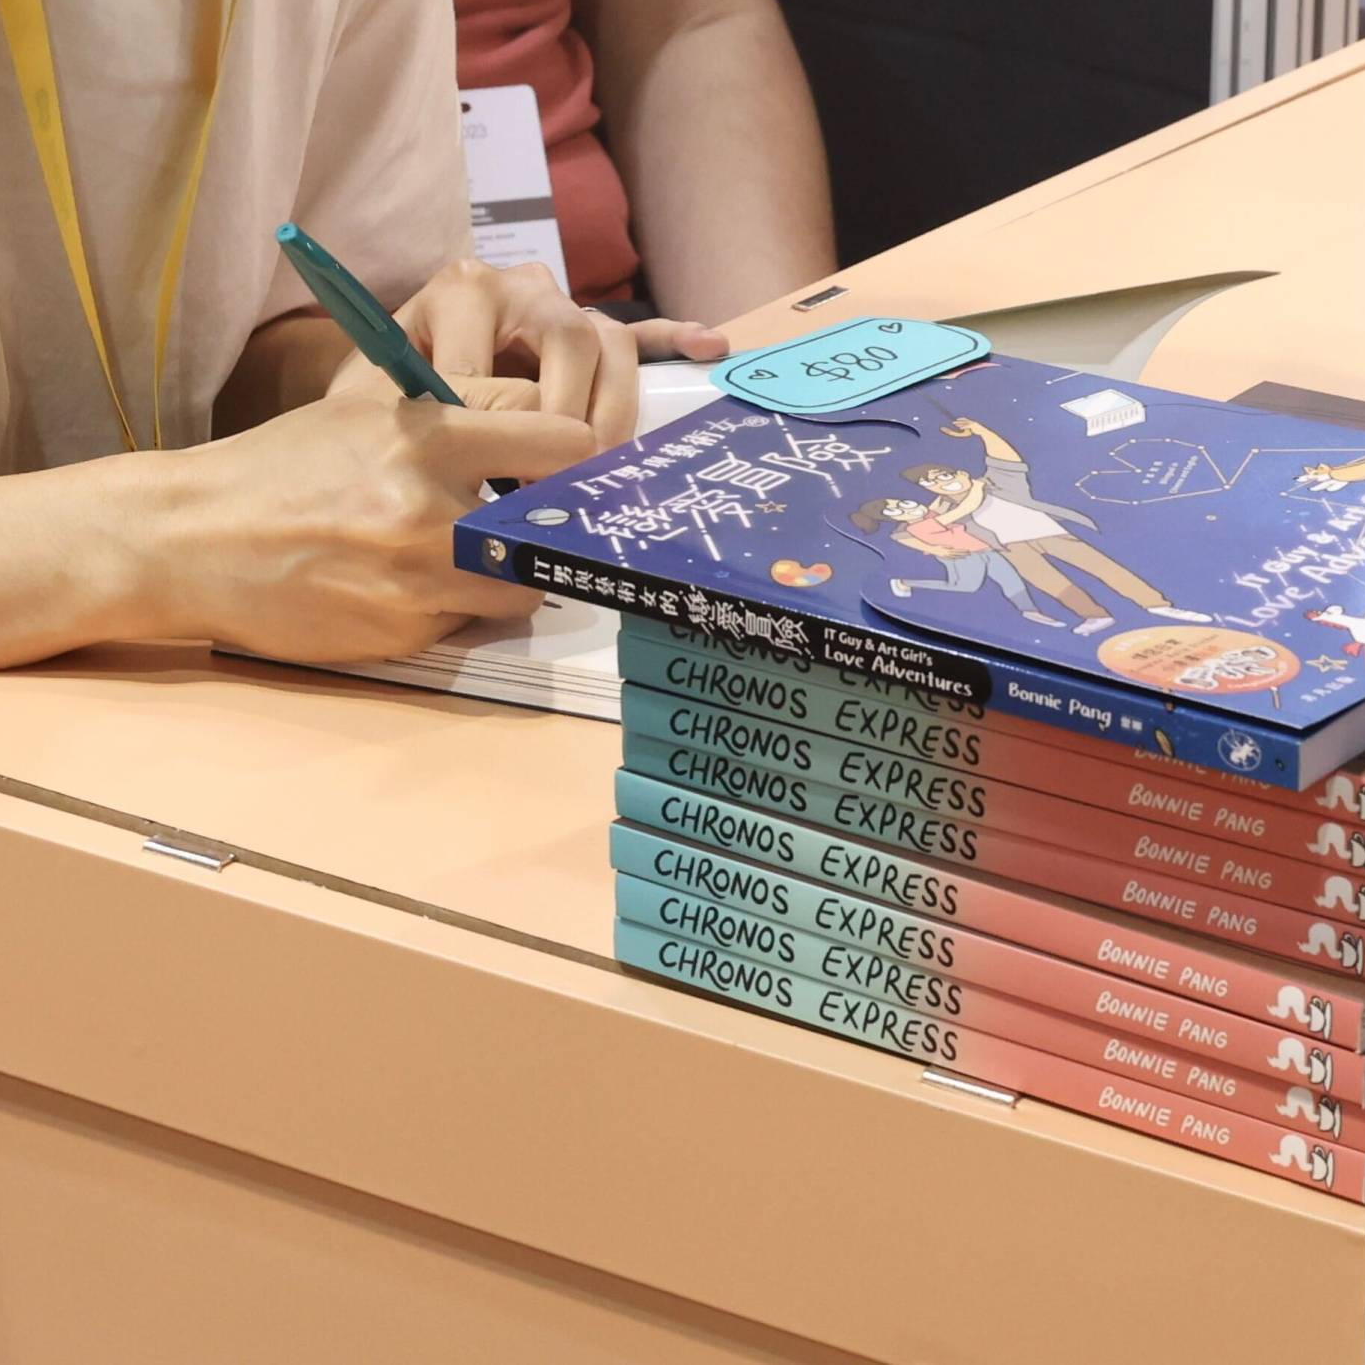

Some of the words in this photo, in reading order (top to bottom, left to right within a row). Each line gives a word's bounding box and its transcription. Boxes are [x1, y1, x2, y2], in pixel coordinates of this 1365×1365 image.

[805, 344, 899, 384] $80
[1225, 585, 1316, 629] Love
[1306, 529, 1336, 545] &
[823, 627, 838, 642] IT
[838, 631, 864, 653] Guy
[864, 638, 876, 653] &
[877, 641, 900, 659] Art
[900, 646, 933, 668] Girl's
[823, 643, 865, 670] Love
[871, 654, 973, 698] Adventures
[1007, 681, 1064, 713] Bonnie
[1068, 697, 1113, 731] Pang
[666, 657, 808, 721] CHRONOS
[835, 700, 981, 766] EXPRESS
[1128, 783, 1204, 821] BONNIE
[1214, 807, 1266, 837] PANG
[670, 708, 812, 771] CHRONOS
[839, 752, 986, 819] EXPRESS
[1134, 835, 1211, 875] BONNIE
[1220, 860, 1273, 890] PANG
[660, 797, 795, 863] CHRONOS
[820, 845, 959, 916] EXPRESS
[1097, 938, 1171, 980] BONNIE
[1178, 966, 1229, 998] PANG
[669, 748, 808, 812] CHRONOS
[834, 794, 978, 862] EXPRESS
[1122, 881, 1197, 920] BONNIE
[1207, 906, 1258, 936] PANG
[654, 849, 789, 916] CHRONOS
[815, 898, 955, 969] EXPRESS
[1095, 990, 1170, 1032] BONNIE
[1178, 1018, 1228, 1049] PANG
[659, 897, 796, 964] CHRONOS
[822, 945, 963, 1016] EXPRESS
[1103, 1038, 1178, 1079] BONNIE
[1186, 1066, 1237, 1097] PANG
[658, 941, 793, 1008] CHRONOS
[819, 991, 958, 1062] EXPRESS
[1098, 1086, 1172, 1127] BONNIE
[1180, 1114, 1231, 1145] PANG
